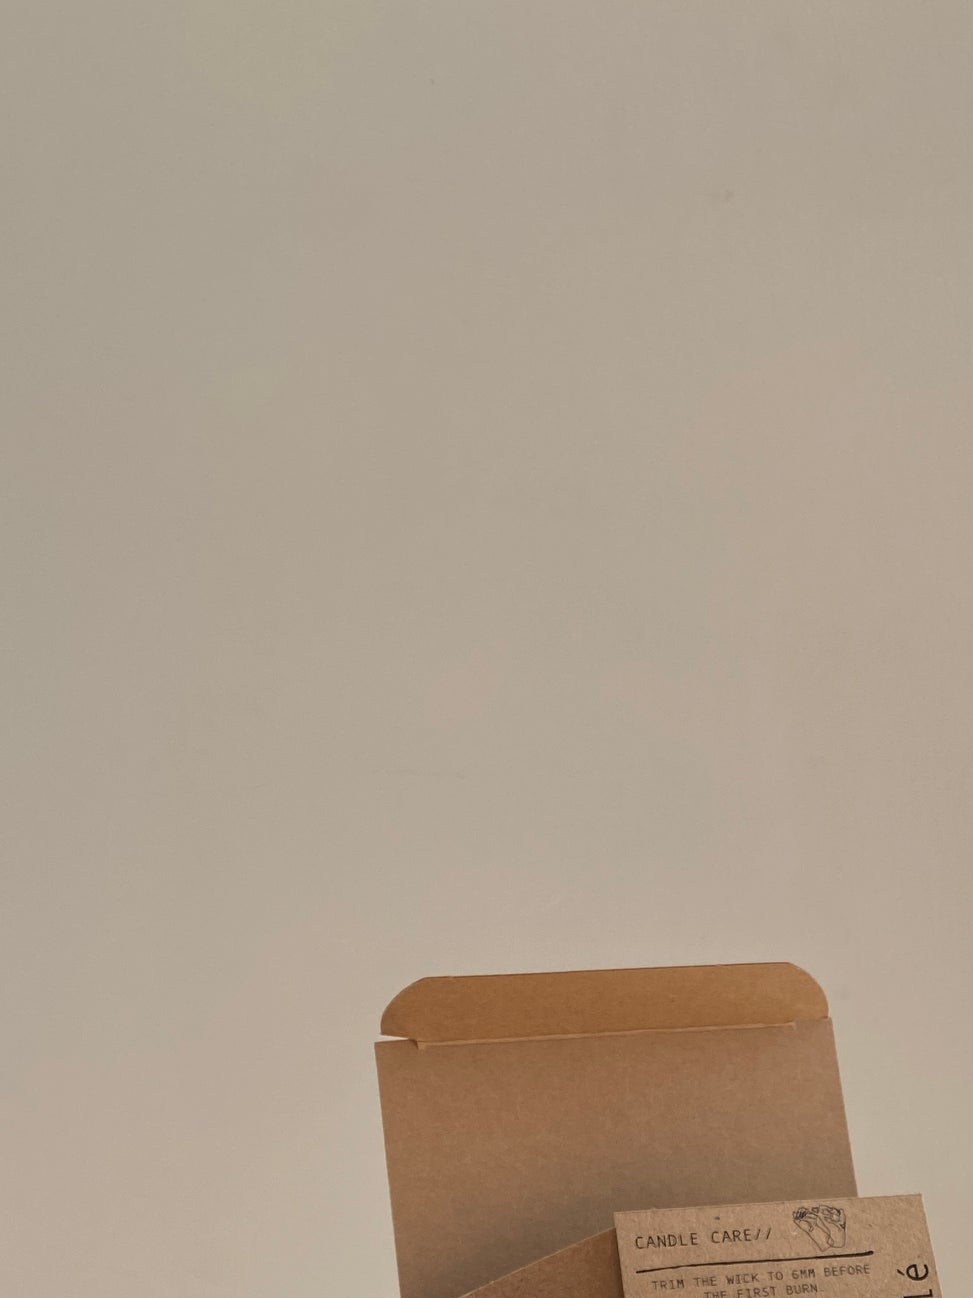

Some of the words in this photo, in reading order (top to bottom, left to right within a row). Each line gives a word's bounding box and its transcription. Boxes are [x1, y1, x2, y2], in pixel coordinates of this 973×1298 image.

[635, 1232, 699, 1249] CANDLE
[711, 1227, 772, 1244] CARE//
[652, 1278, 685, 1290] TRIM
[693, 1276, 717, 1287] THE
[726, 1273, 759, 1285] WICK
[768, 1271, 783, 1281] TO
[791, 1268, 816, 1280] 6MM
[824, 1264, 871, 1277] BEFORE
[737, 1287, 776, 1298] FIRST
